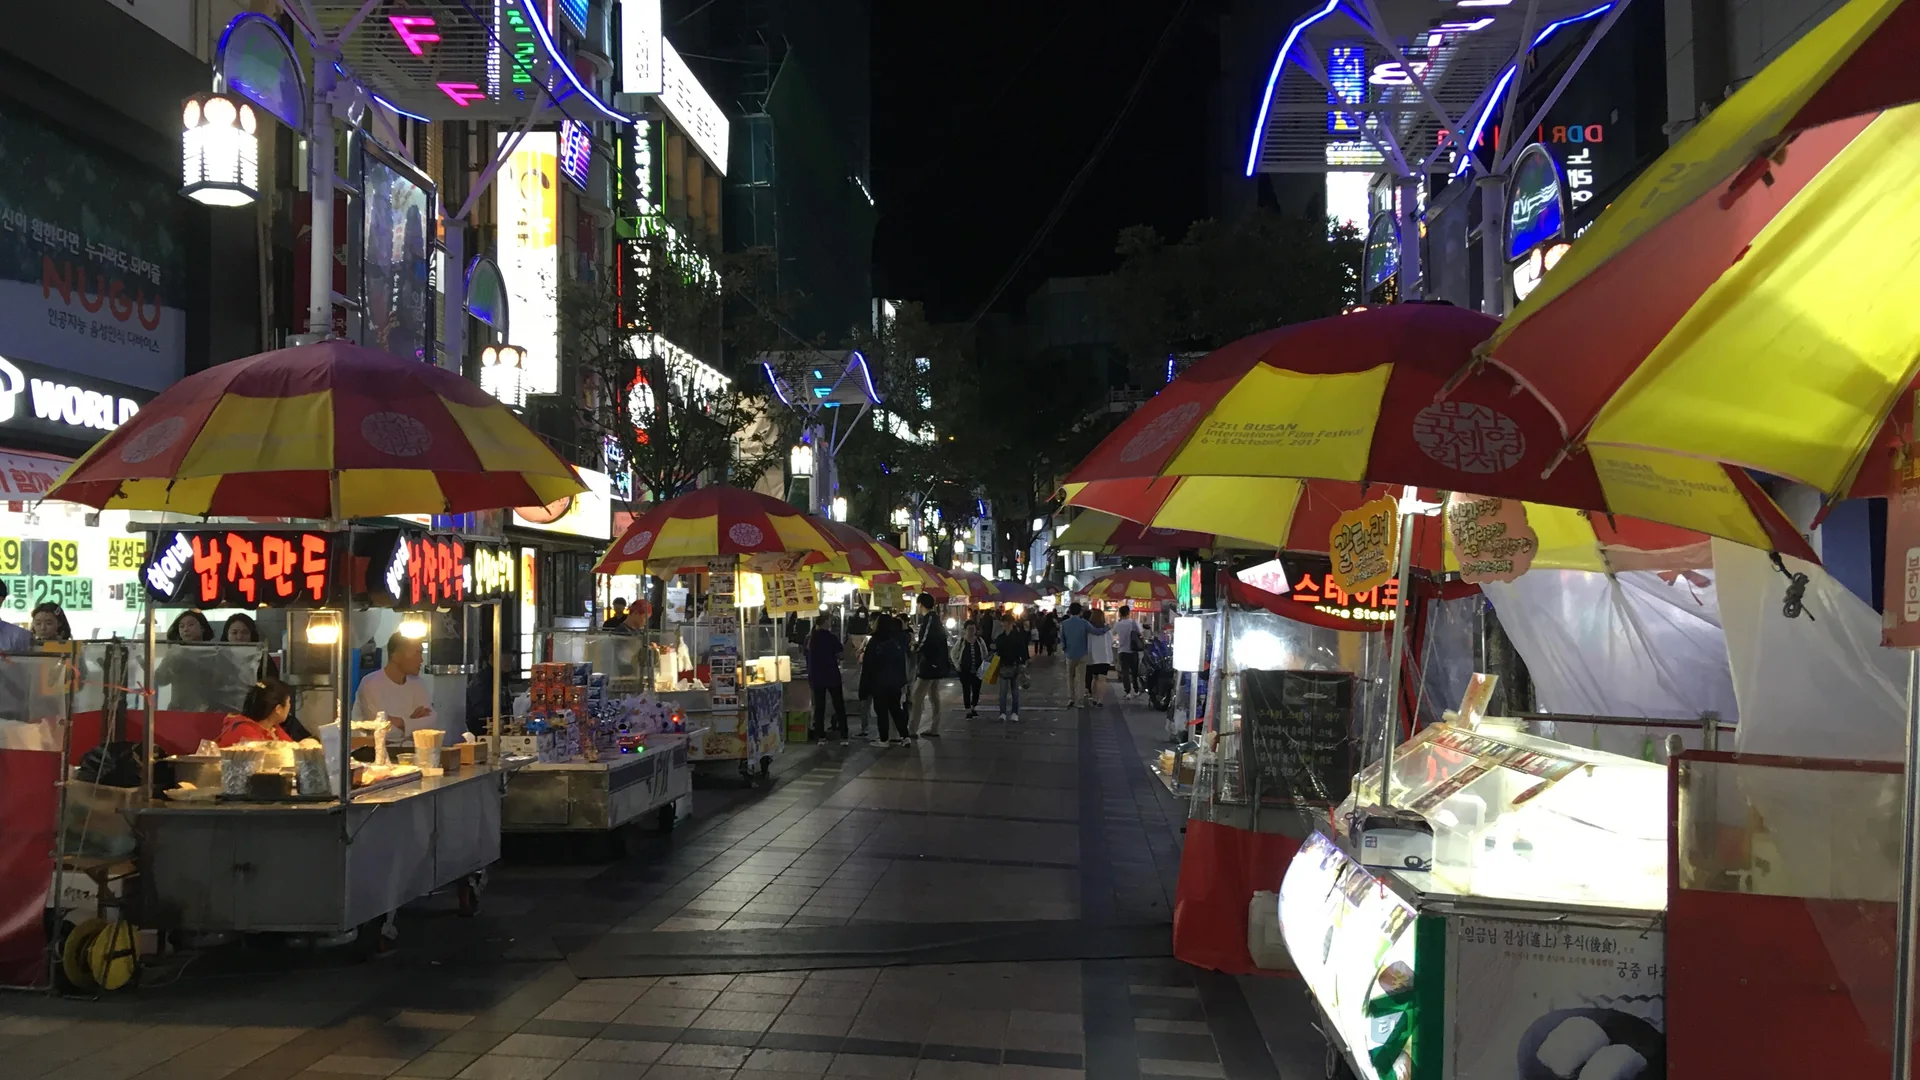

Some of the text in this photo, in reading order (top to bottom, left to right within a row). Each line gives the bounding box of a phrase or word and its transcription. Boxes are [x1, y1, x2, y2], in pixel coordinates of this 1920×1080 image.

[31, 217, 80, 255] 원한다면
[85, 237, 129, 272] 누구라도
[43, 255, 161, 331] NUGU
[48, 308, 160, 353] 인공지능 음성인식 디바이스
[31, 378, 140, 431] WORLD
[1205, 427, 1365, 439] International Film Festival
[1243, 423, 1298, 431] BUSAN
[1289, 438, 1321, 446] 2017
[50, 542, 78, 572] S9
[1334, 510, 1390, 574] 꿀타래
[191, 532, 327, 602] 납작만두
[34, 579, 93, 609] 25만원
[1464, 928, 1498, 945] 임금님
[1502, 931, 1557, 949] 진상(進上)
[1616, 961, 1641, 979] 궁중
